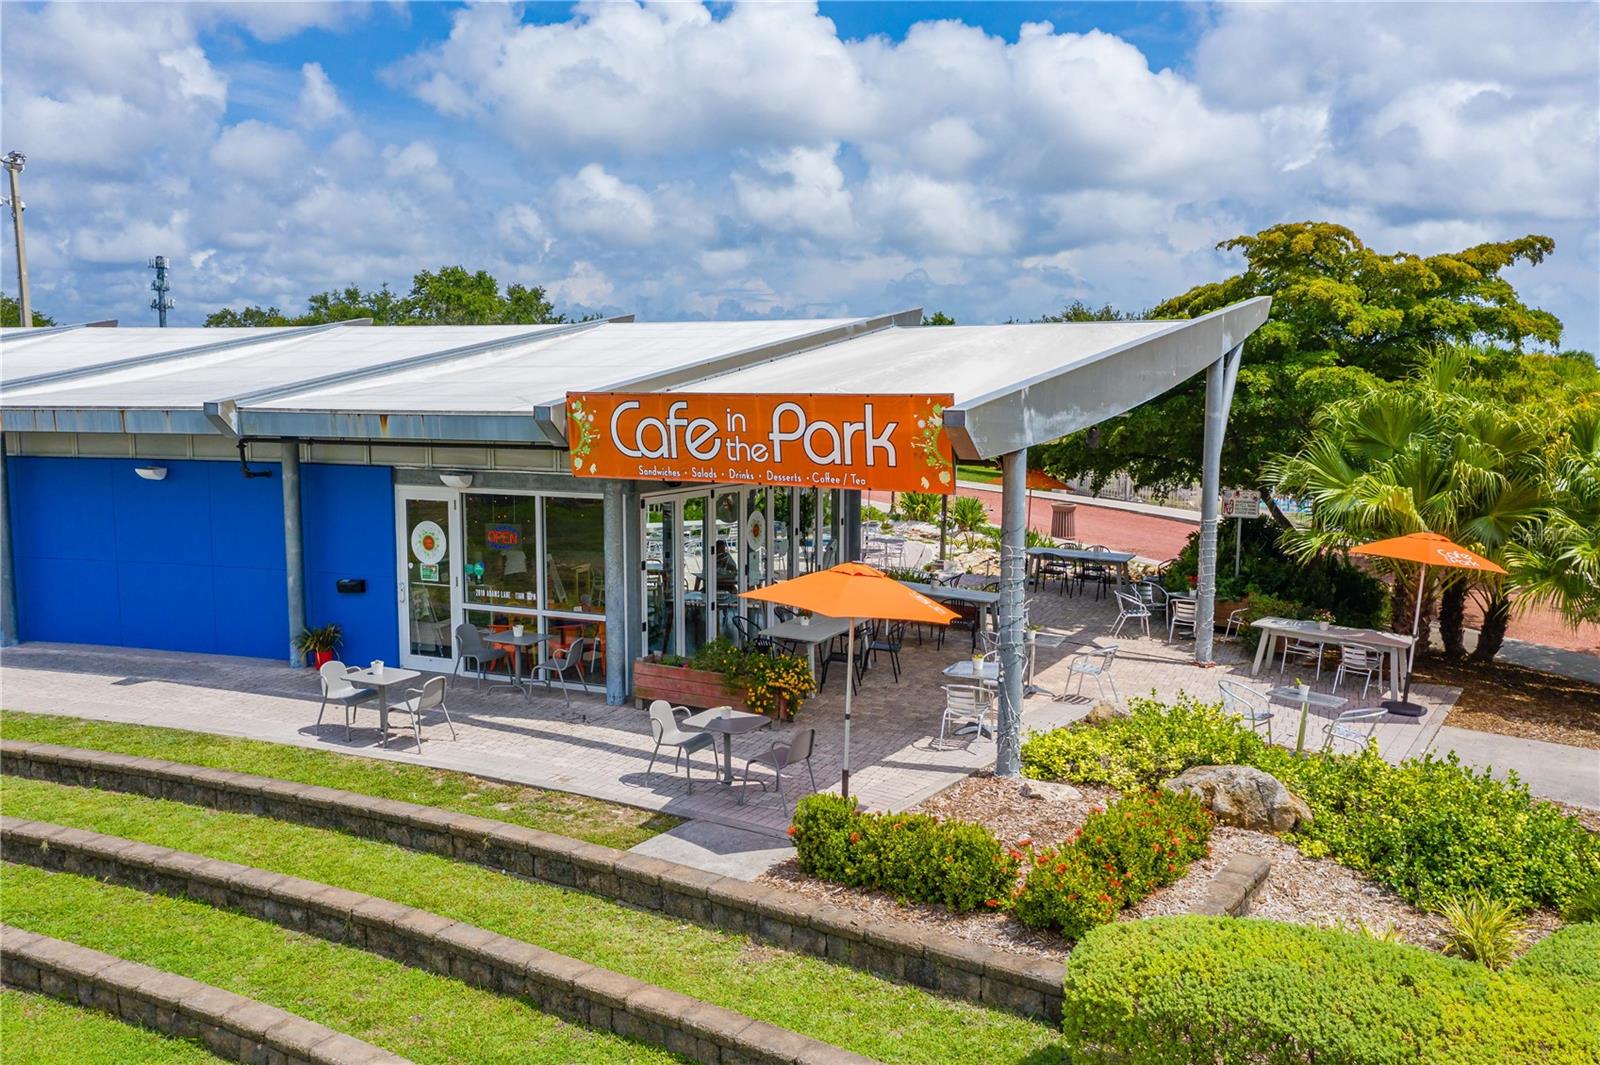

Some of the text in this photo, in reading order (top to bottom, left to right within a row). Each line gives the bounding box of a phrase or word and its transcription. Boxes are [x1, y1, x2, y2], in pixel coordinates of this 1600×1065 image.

[610, 400, 900, 467] Cafe in the Park
[638, 464, 681, 477] Sandwiches
[691, 466, 718, 478] Salads
[729, 467, 754, 480] Drinks
[766, 470, 802, 482] Desserts
[812, 471, 840, 484] Coffee
[850, 473, 866, 486] Tea
[487, 529, 518, 545] OPEN
